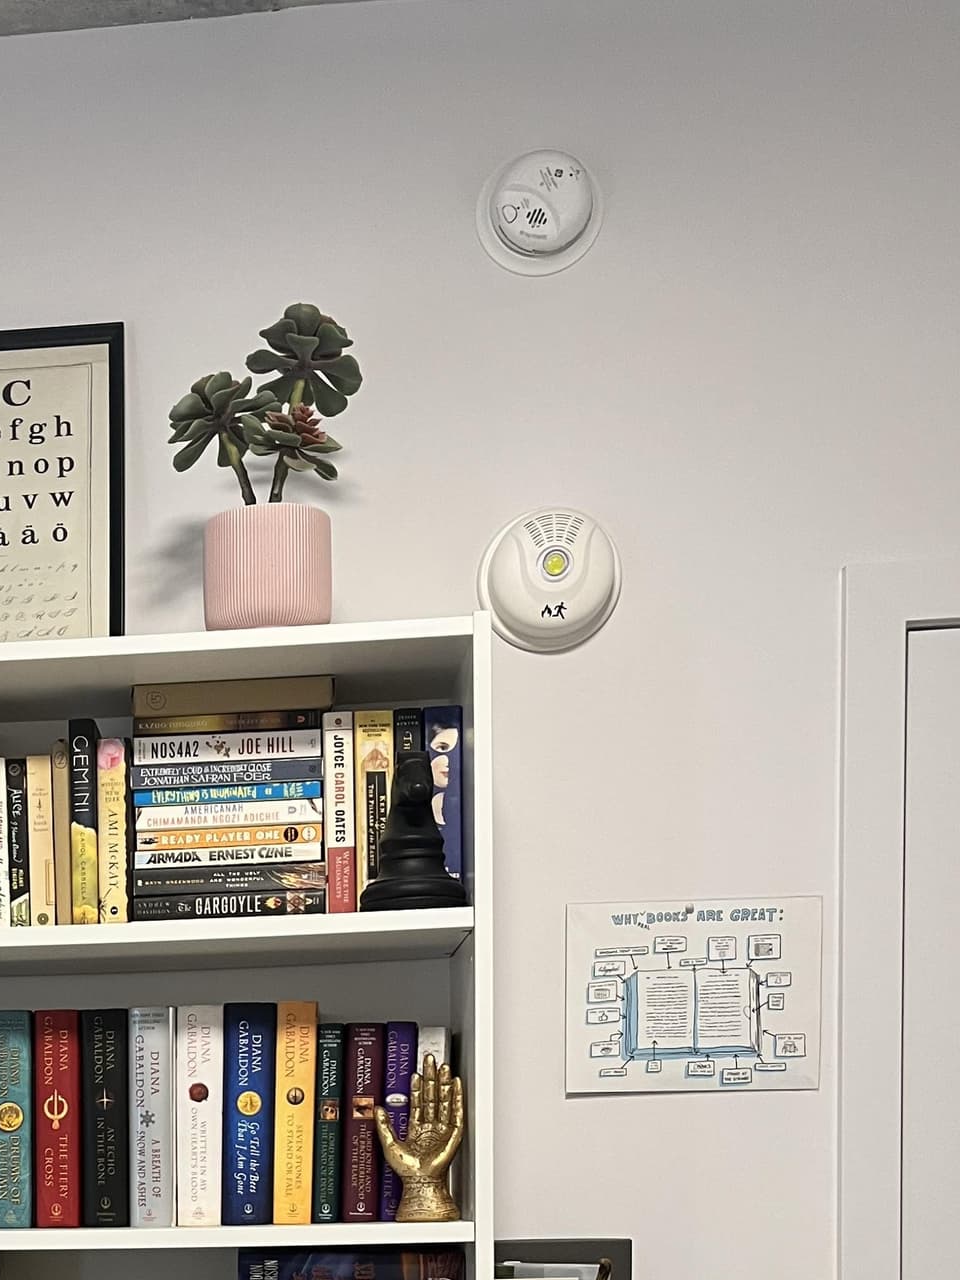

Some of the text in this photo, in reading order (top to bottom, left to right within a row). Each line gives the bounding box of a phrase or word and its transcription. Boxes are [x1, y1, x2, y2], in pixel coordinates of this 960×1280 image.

[150, 736, 295, 759] NOS4A2 JOE HILL
[72, 736, 89, 812] GEMINI
[333, 734, 346, 843] JOYCE CAROL OATES
[161, 830, 280, 845] READY PLAYER ONE
[145, 847, 292, 865] ARMADA ERNEST CLINE
[194, 895, 262, 915] GARGOYLE
[611, 908, 784, 925] WHY BOOKS ARE GREAT:
[238, 1020, 249, 1086] GABALDON
[251, 1034, 262, 1073] DIANA
